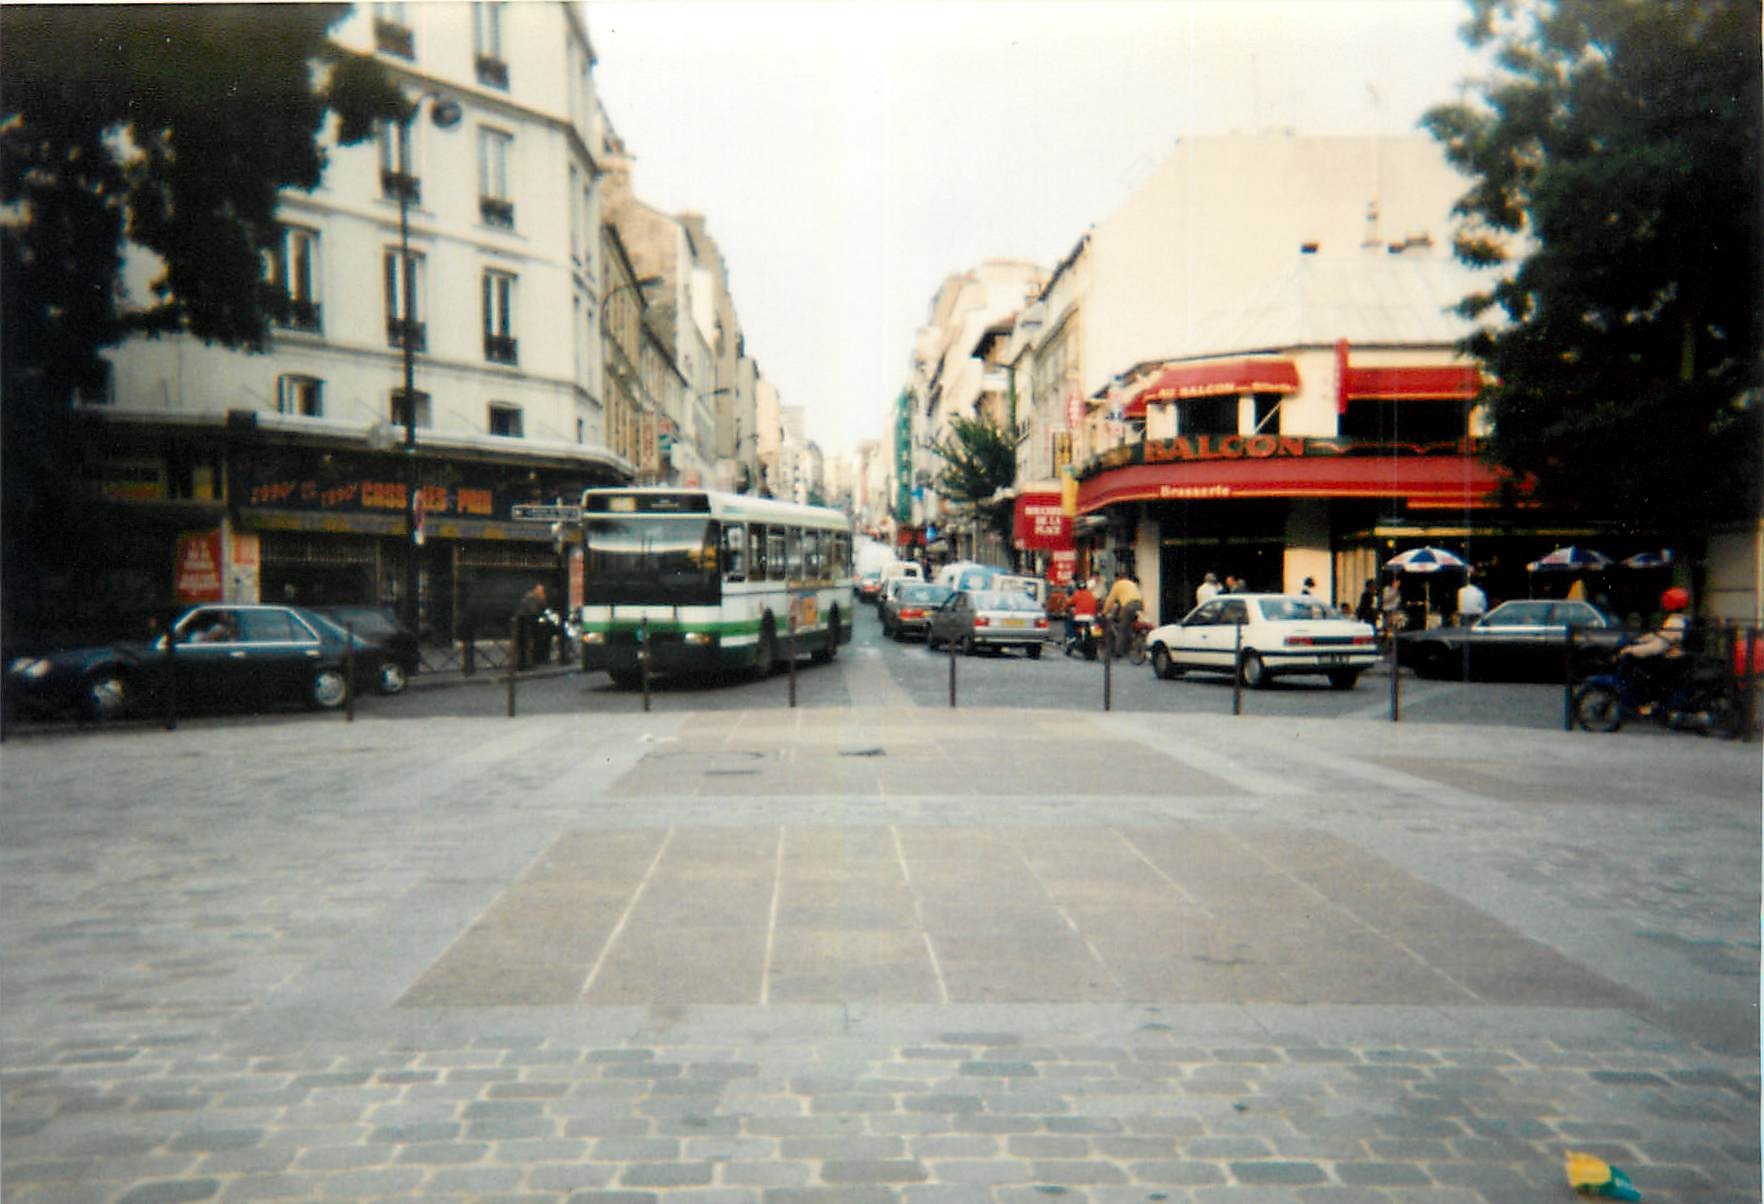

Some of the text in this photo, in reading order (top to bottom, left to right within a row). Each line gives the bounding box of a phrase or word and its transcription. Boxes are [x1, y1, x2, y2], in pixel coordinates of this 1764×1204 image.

[1179, 382, 1235, 396] BALCON
[1144, 434, 1304, 462] BALCON
[1160, 485, 1232, 498] Brasserie
